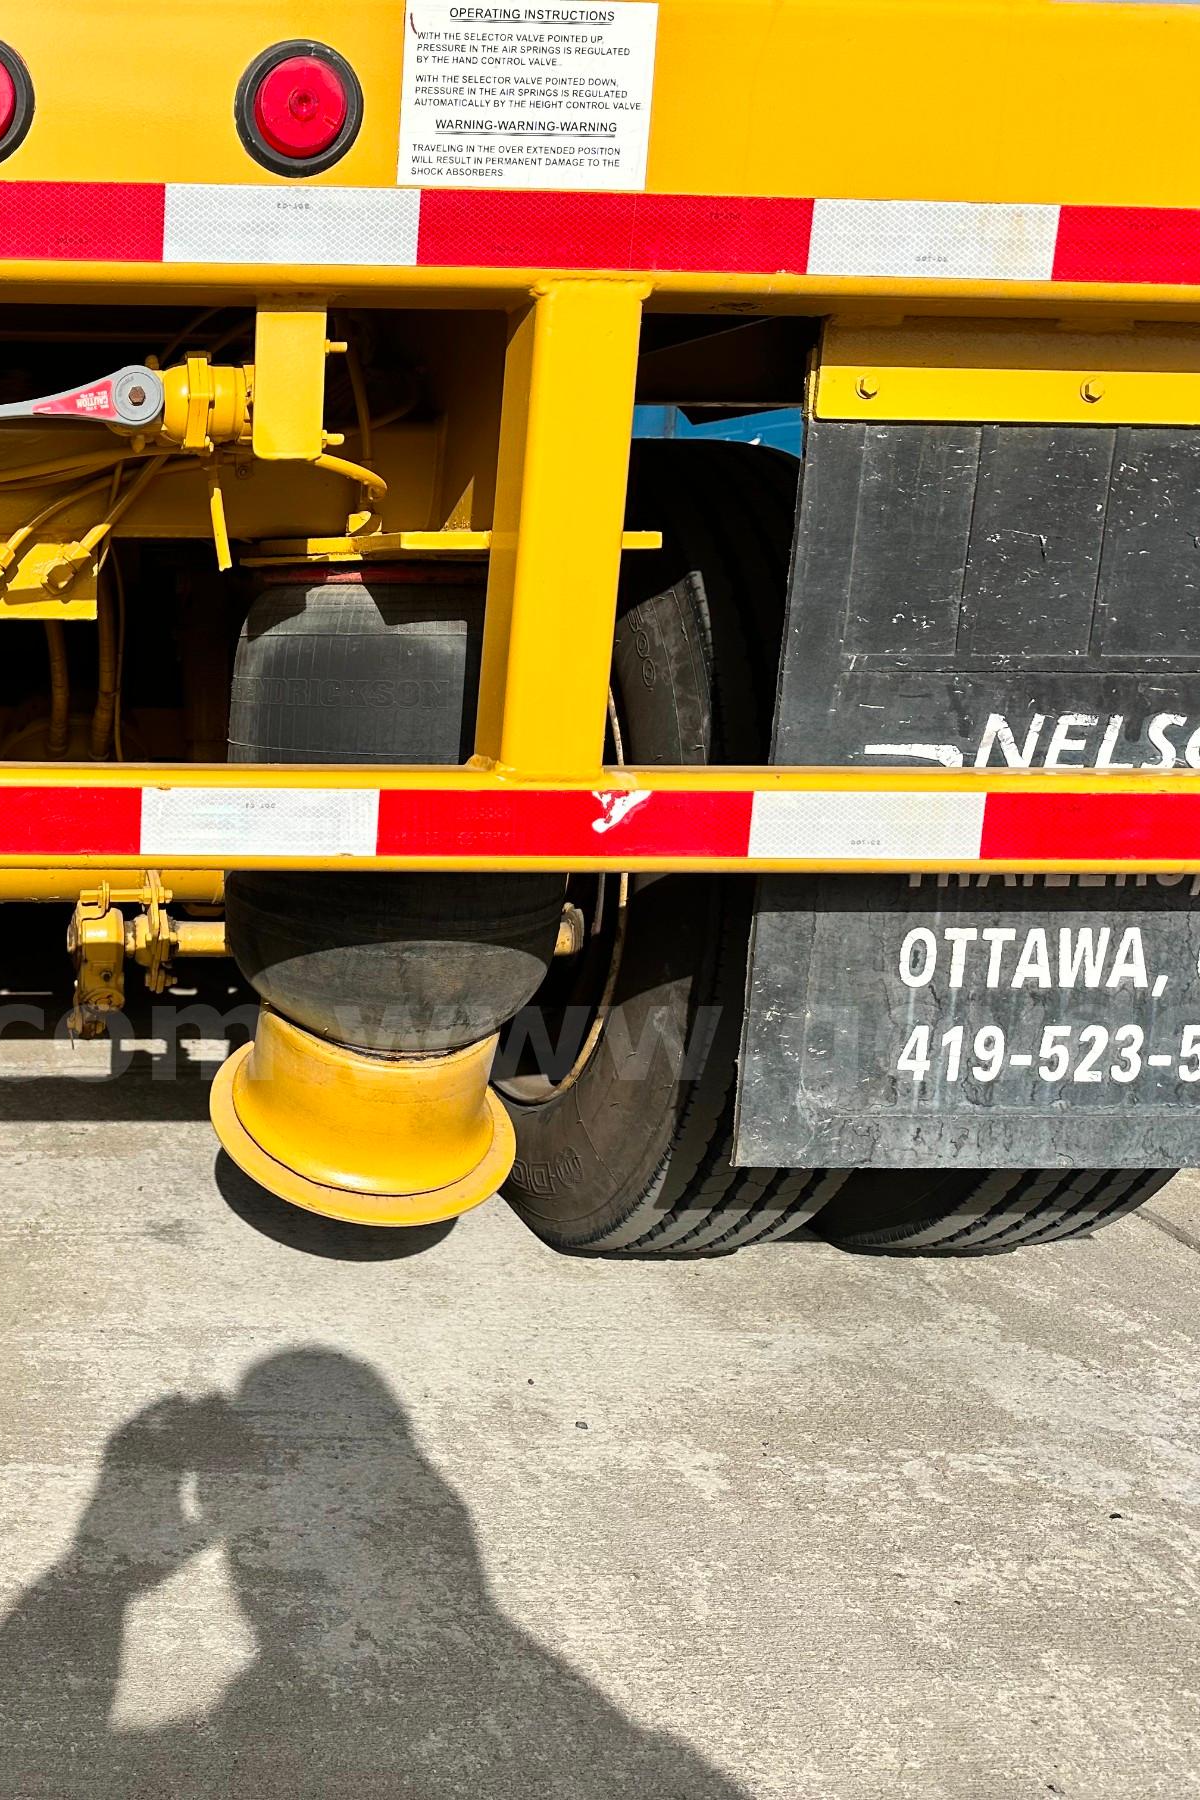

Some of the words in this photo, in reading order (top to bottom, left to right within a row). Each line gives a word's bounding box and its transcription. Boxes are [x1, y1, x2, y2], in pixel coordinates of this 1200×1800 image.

[450, 7, 520, 19] OPERATING
[524, 9, 615, 21] INSTRUCTIONS
[417, 31, 440, 40] WITH
[443, 32, 461, 40] THE
[464, 33, 513, 41] SELECTOR
[516, 34, 545, 42] VALVE
[547, 35, 588, 43] POINTED
[417, 44, 466, 52] PRESSURE
[469, 44, 478, 53] IN
[481, 45, 498, 53] THE
[502, 45, 517, 53] AIR
[520, 46, 561, 54] SPRINGS
[564, 46, 572, 55] IS
[575, 47, 630, 56] REGULATED
[417, 55, 429, 64] BY
[432, 56, 449, 64] THE
[452, 56, 478, 64] HAND
[481, 57, 526, 66] CONTROL
[416, 74, 439, 83] WITH
[441, 75, 459, 83] THE
[461, 75, 511, 84] SELECTOR
[514, 77, 543, 85] VALVE
[545, 77, 585, 86] POINTED
[415, 86, 464, 95] PRESSURE
[468, 87, 476, 95] IN
[479, 88, 496, 96] THE
[500, 88, 515, 96] AIR
[518, 89, 558, 97] SPRINGS
[572, 90, 627, 98] REGULATED
[414, 98, 490, 108] AUTOMATICALLY
[493, 100, 505, 108] BY
[509, 100, 526, 108] THE
[529, 101, 563, 109] HEIGHT
[565, 101, 610, 110] CONTROL
[435, 119, 617, 132] WARNING-WARNING-WARNING
[412, 144, 464, 153] TRAVELING
[466, 145, 474, 153] IN
[477, 145, 495, 153] THE
[498, 145, 523, 154] OVER
[527, 146, 575, 155] EXTENDED
[578, 147, 620, 155] POSITION
[411, 155, 433, 164] WILL
[436, 156, 471, 164] RESULT
[485, 157, 542, 166] PERMANENT
[545, 158, 585, 166] DAMAGE
[603, 159, 620, 167] THE
[411, 167, 443, 175] SHOCK
[974, 713, 1200, 768] NELS
[899, 927, 1169, 997] OTTAWA,
